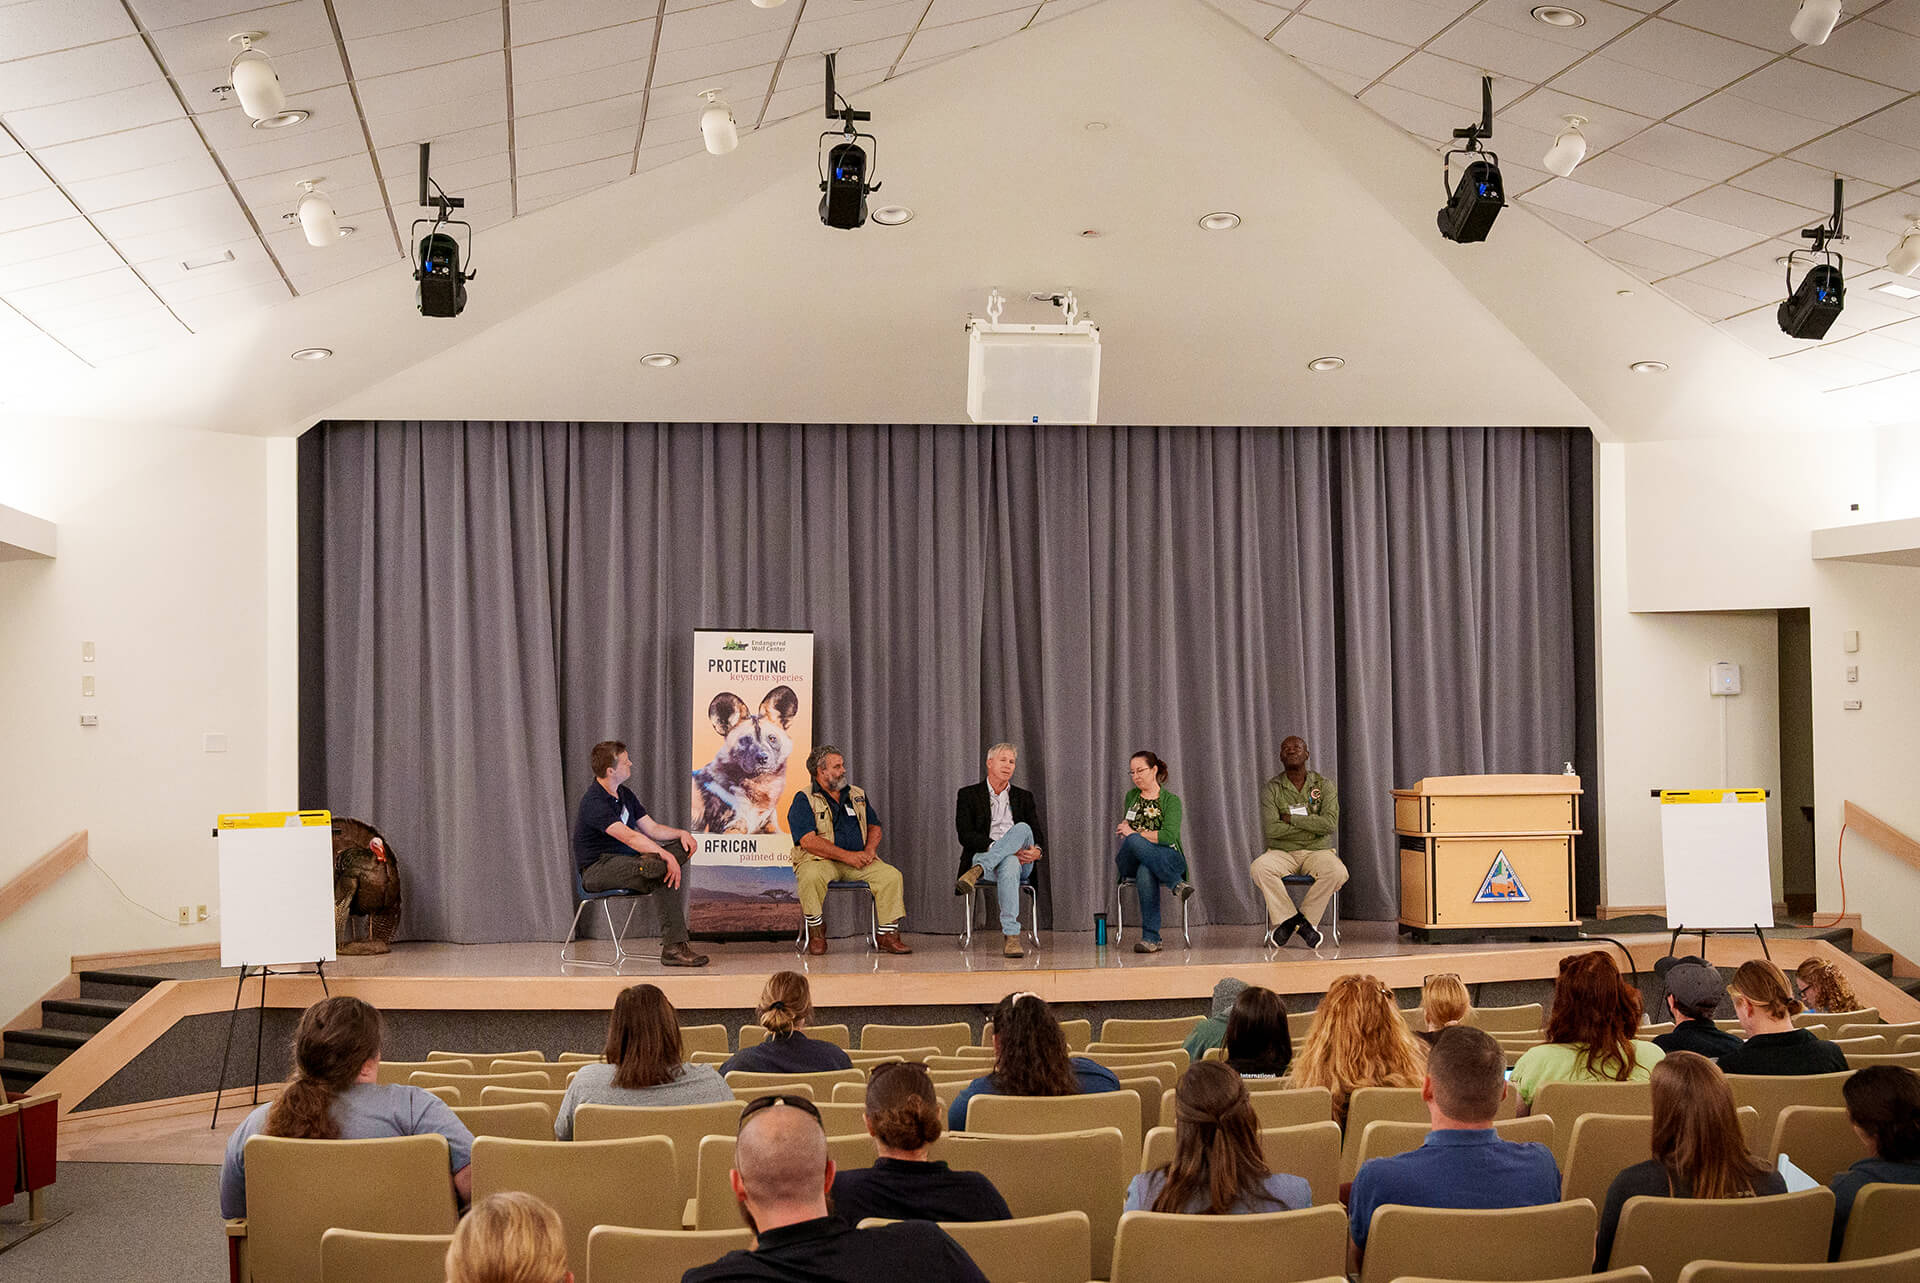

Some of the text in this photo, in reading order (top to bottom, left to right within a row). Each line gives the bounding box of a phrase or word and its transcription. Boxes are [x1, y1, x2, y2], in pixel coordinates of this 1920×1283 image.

[708, 659, 786, 673] PROTECTING
[730, 673, 804, 683] keystone species
[704, 839, 757, 853] AFRICAN
[739, 853, 774, 863] painted
